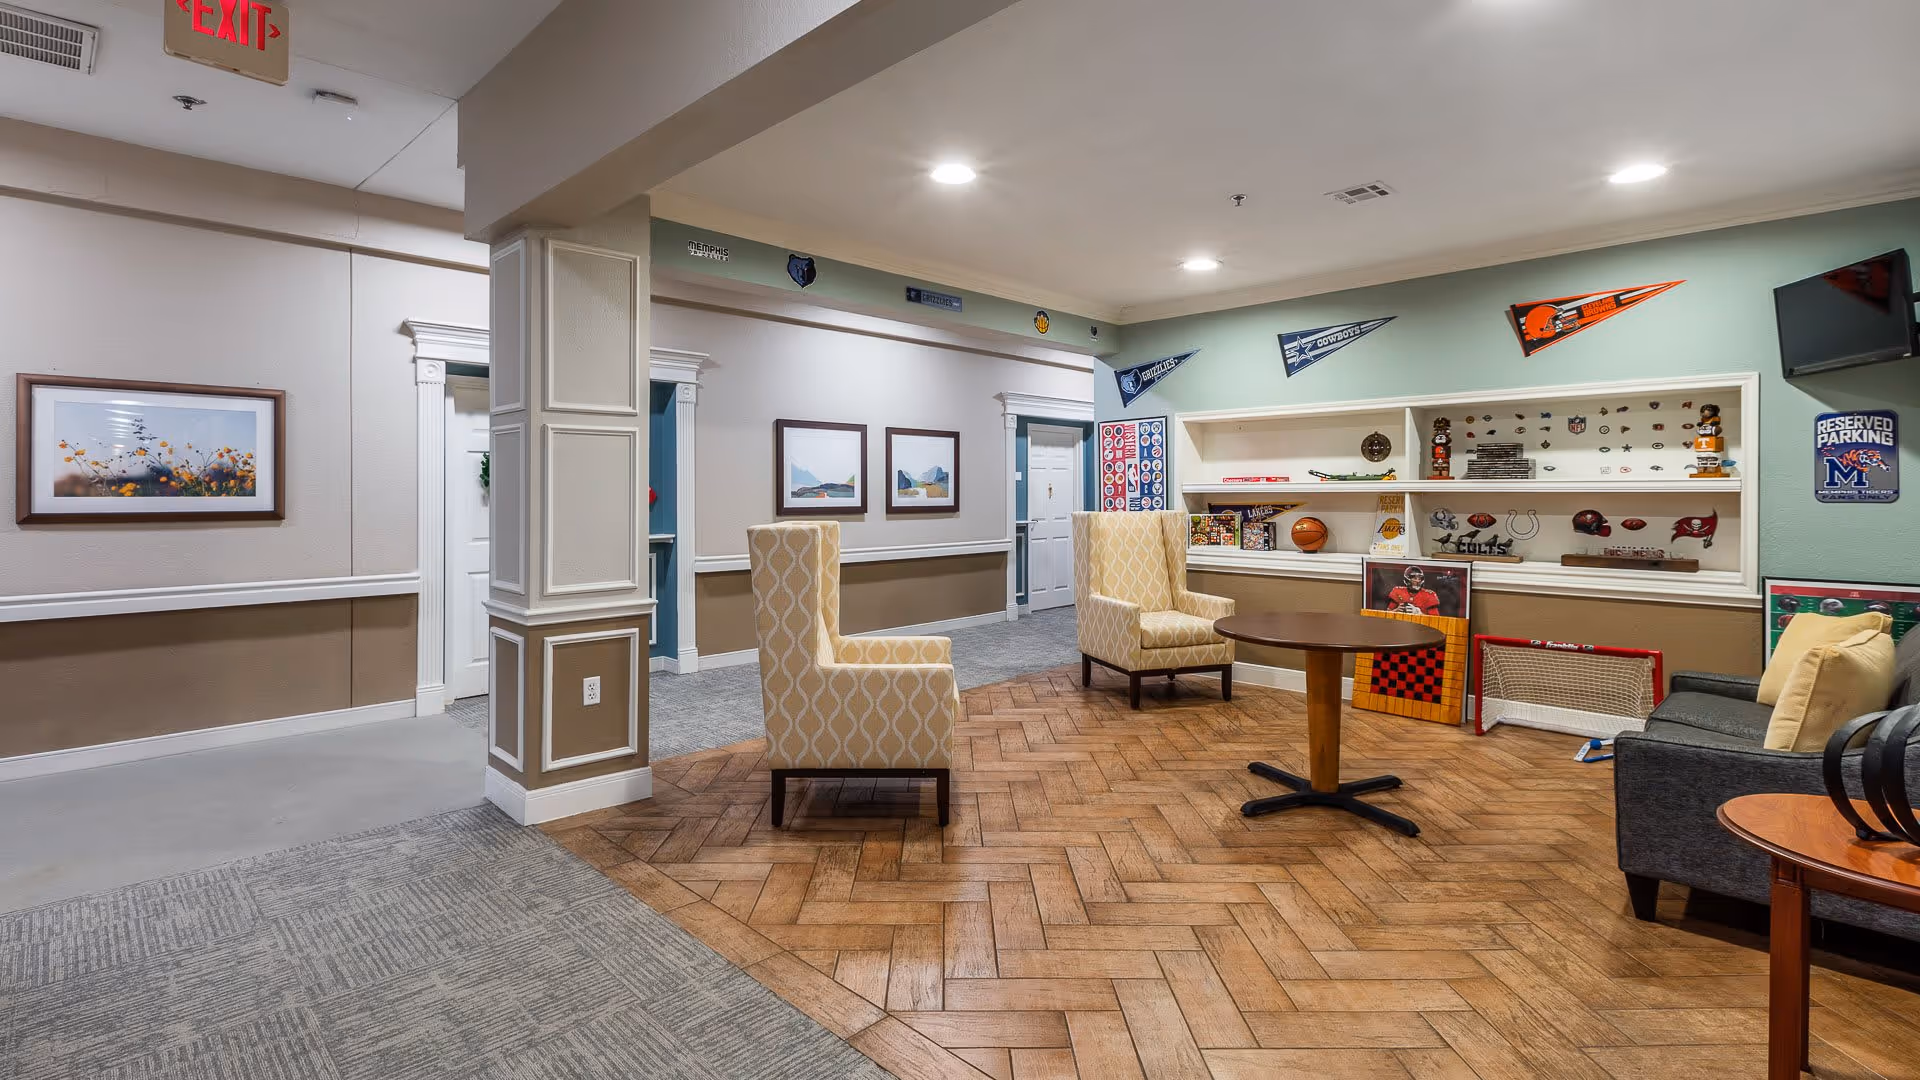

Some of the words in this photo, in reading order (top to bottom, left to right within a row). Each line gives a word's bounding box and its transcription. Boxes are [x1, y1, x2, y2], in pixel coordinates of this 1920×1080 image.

[192, 0, 272, 51] EXIT
[688, 240, 729, 256] MEMPHIS
[922, 292, 953, 307] GRIZZLIES
[1583, 301, 1617, 318] BROWNS
[1317, 325, 1361, 347] COWBOYS
[1141, 358, 1176, 381] GRIZZLIES
[1569, 423, 1585, 433] NFL
[1817, 415, 1893, 435] RESERVED
[1124, 423, 1137, 459] WESTERN
[1697, 437, 1711, 449] T
[1817, 429, 1894, 448] PARKING
[1823, 456, 1869, 488] M
[1248, 505, 1273, 518] LAKERS
[1376, 522, 1406, 536] LAKERS
[1457, 542, 1508, 555] COLTS
